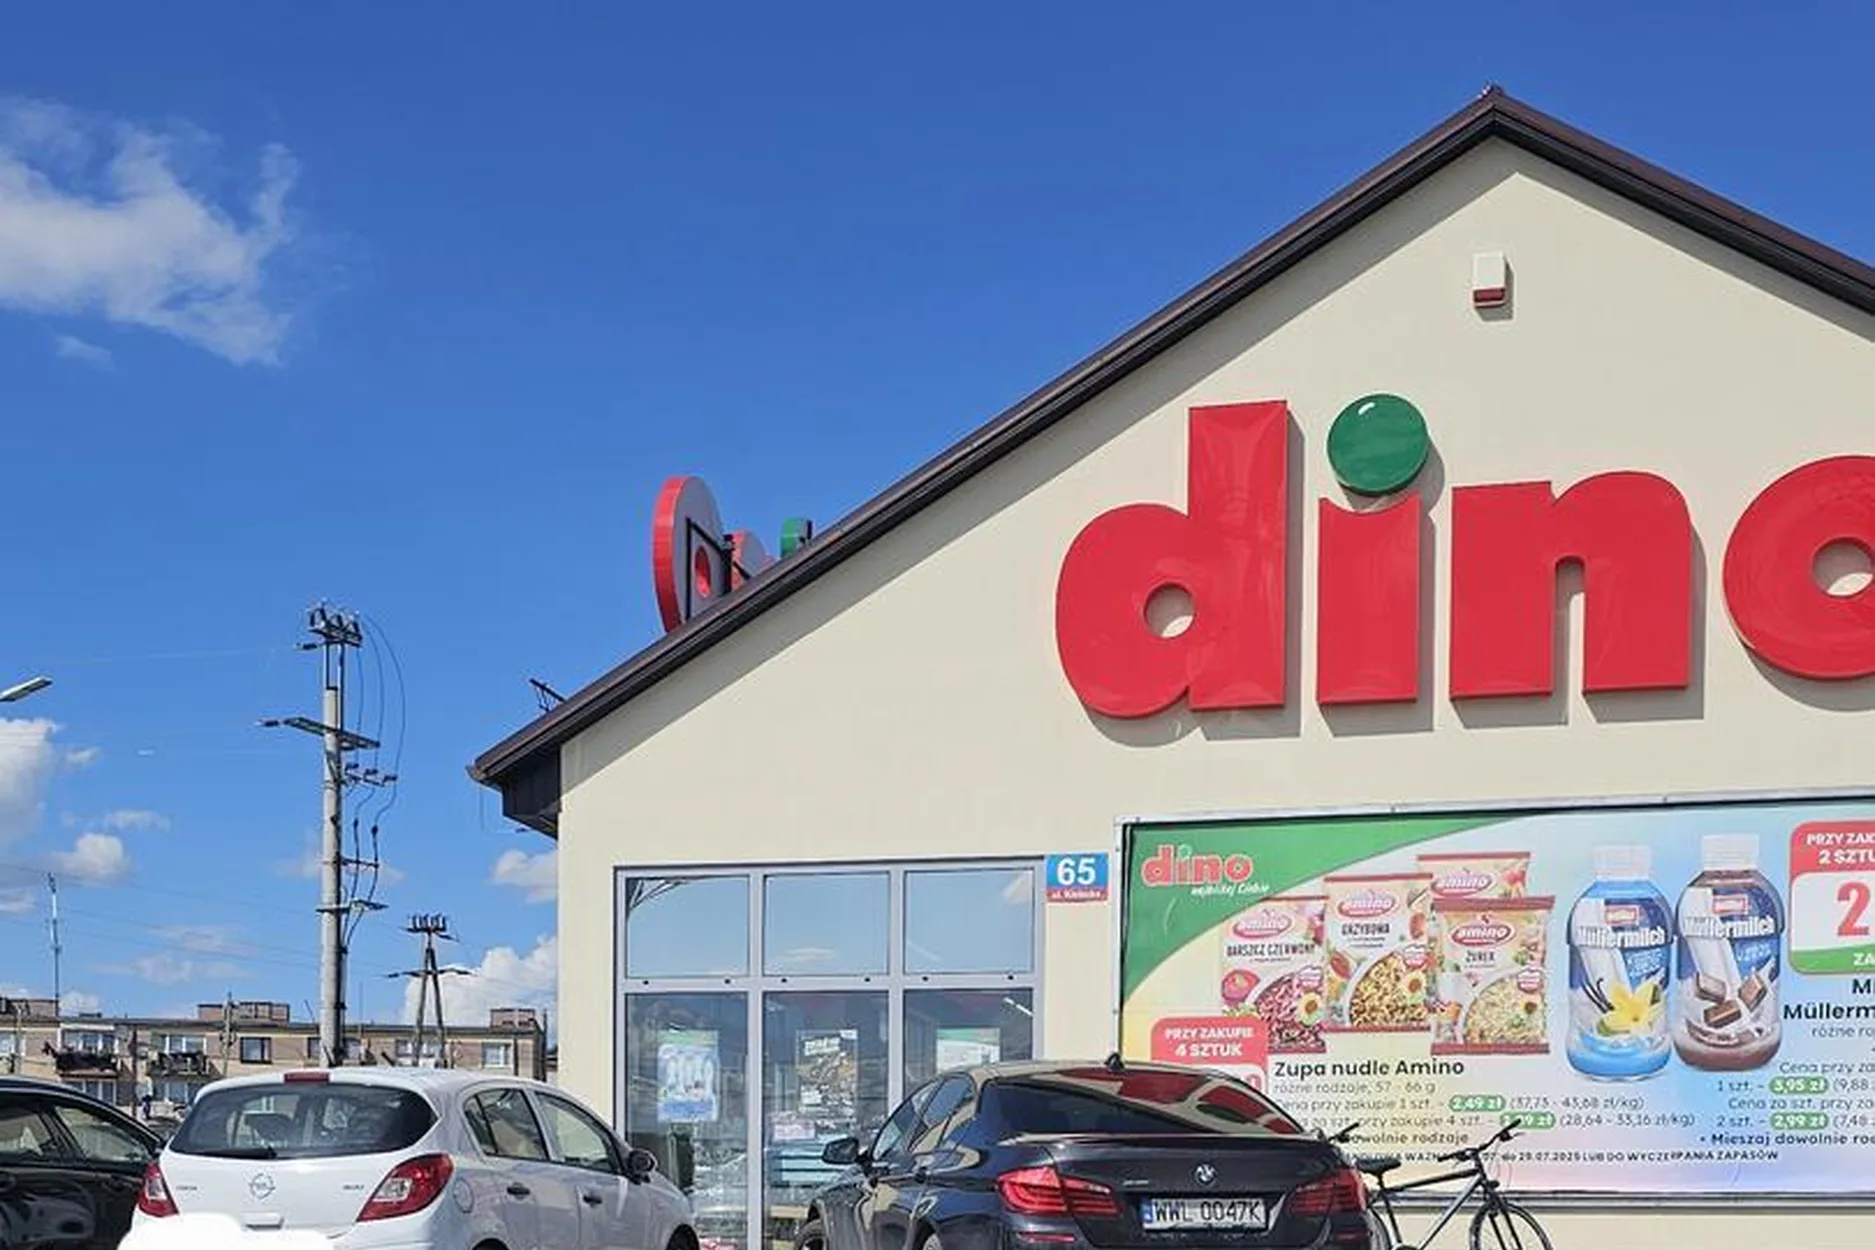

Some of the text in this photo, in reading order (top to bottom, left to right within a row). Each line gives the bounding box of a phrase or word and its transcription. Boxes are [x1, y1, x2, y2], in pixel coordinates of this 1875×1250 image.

[1056, 394, 1875, 718] dino
[1807, 833, 1843, 845] PRZY
[1141, 843, 1253, 887] dino
[1819, 851, 1831, 864] 2
[1057, 857, 1096, 885] 65
[1165, 1027, 1254, 1039] PRZY ZAKUPIE
[1812, 1025, 1856, 1039] różne
[1175, 1042, 1242, 1056] 4 SZTUK
[1274, 1058, 1464, 1080] Zupa nudle Amino
[1779, 1063, 1818, 1074] Cena
[1821, 1064, 1853, 1077] przy
[1275, 1082, 1312, 1095] różne
[1316, 1081, 1372, 1098] rodzaje,
[1375, 1081, 1392, 1093] 57
[1405, 1081, 1423, 1093] 66
[1425, 1083, 1436, 1097] g
[1717, 1080, 1724, 1092] 1
[1729, 1080, 1754, 1092] szt.
[1809, 1079, 1827, 1092] zł
[1311, 1100, 1343, 1113] przy
[1346, 1097, 1397, 1112] zakupie
[1411, 1098, 1434, 1109] szt.
[1453, 1097, 1483, 1111] 2,49
[1488, 1096, 1503, 1109] zł
[1603, 1095, 1645, 1112] zł/kg)
[1729, 1098, 1766, 1110] Cena
[1769, 1099, 1788, 1110] za
[1792, 1098, 1818, 1110] szt.
[1820, 1100, 1853, 1114] przy
[1390, 1114, 1443, 1130] zakupie
[1447, 1115, 1455, 1126] 4
[1460, 1114, 1485, 1126] szt.
[1559, 1112, 1602, 1129] (28,64
[1655, 1113, 1695, 1130] zł/kg)
[1717, 1115, 1726, 1128] 2
[1729, 1116, 1754, 1128] szt.
[1774, 1115, 1806, 1129] 2,99
[1809, 1113, 1827, 1127] zł
[1413, 1132, 1469, 1147] rodzaje
[1711, 1133, 1771, 1147] Mieszaj
[1774, 1132, 1848, 1145] dowolnie
[1607, 1151, 1625, 1162] DO
[1628, 1150, 1715, 1163] WYCZERPANIA
[1717, 1149, 1779, 1162] ZAPASÓW
[1153, 1200, 1262, 1221] WWL 0047K
